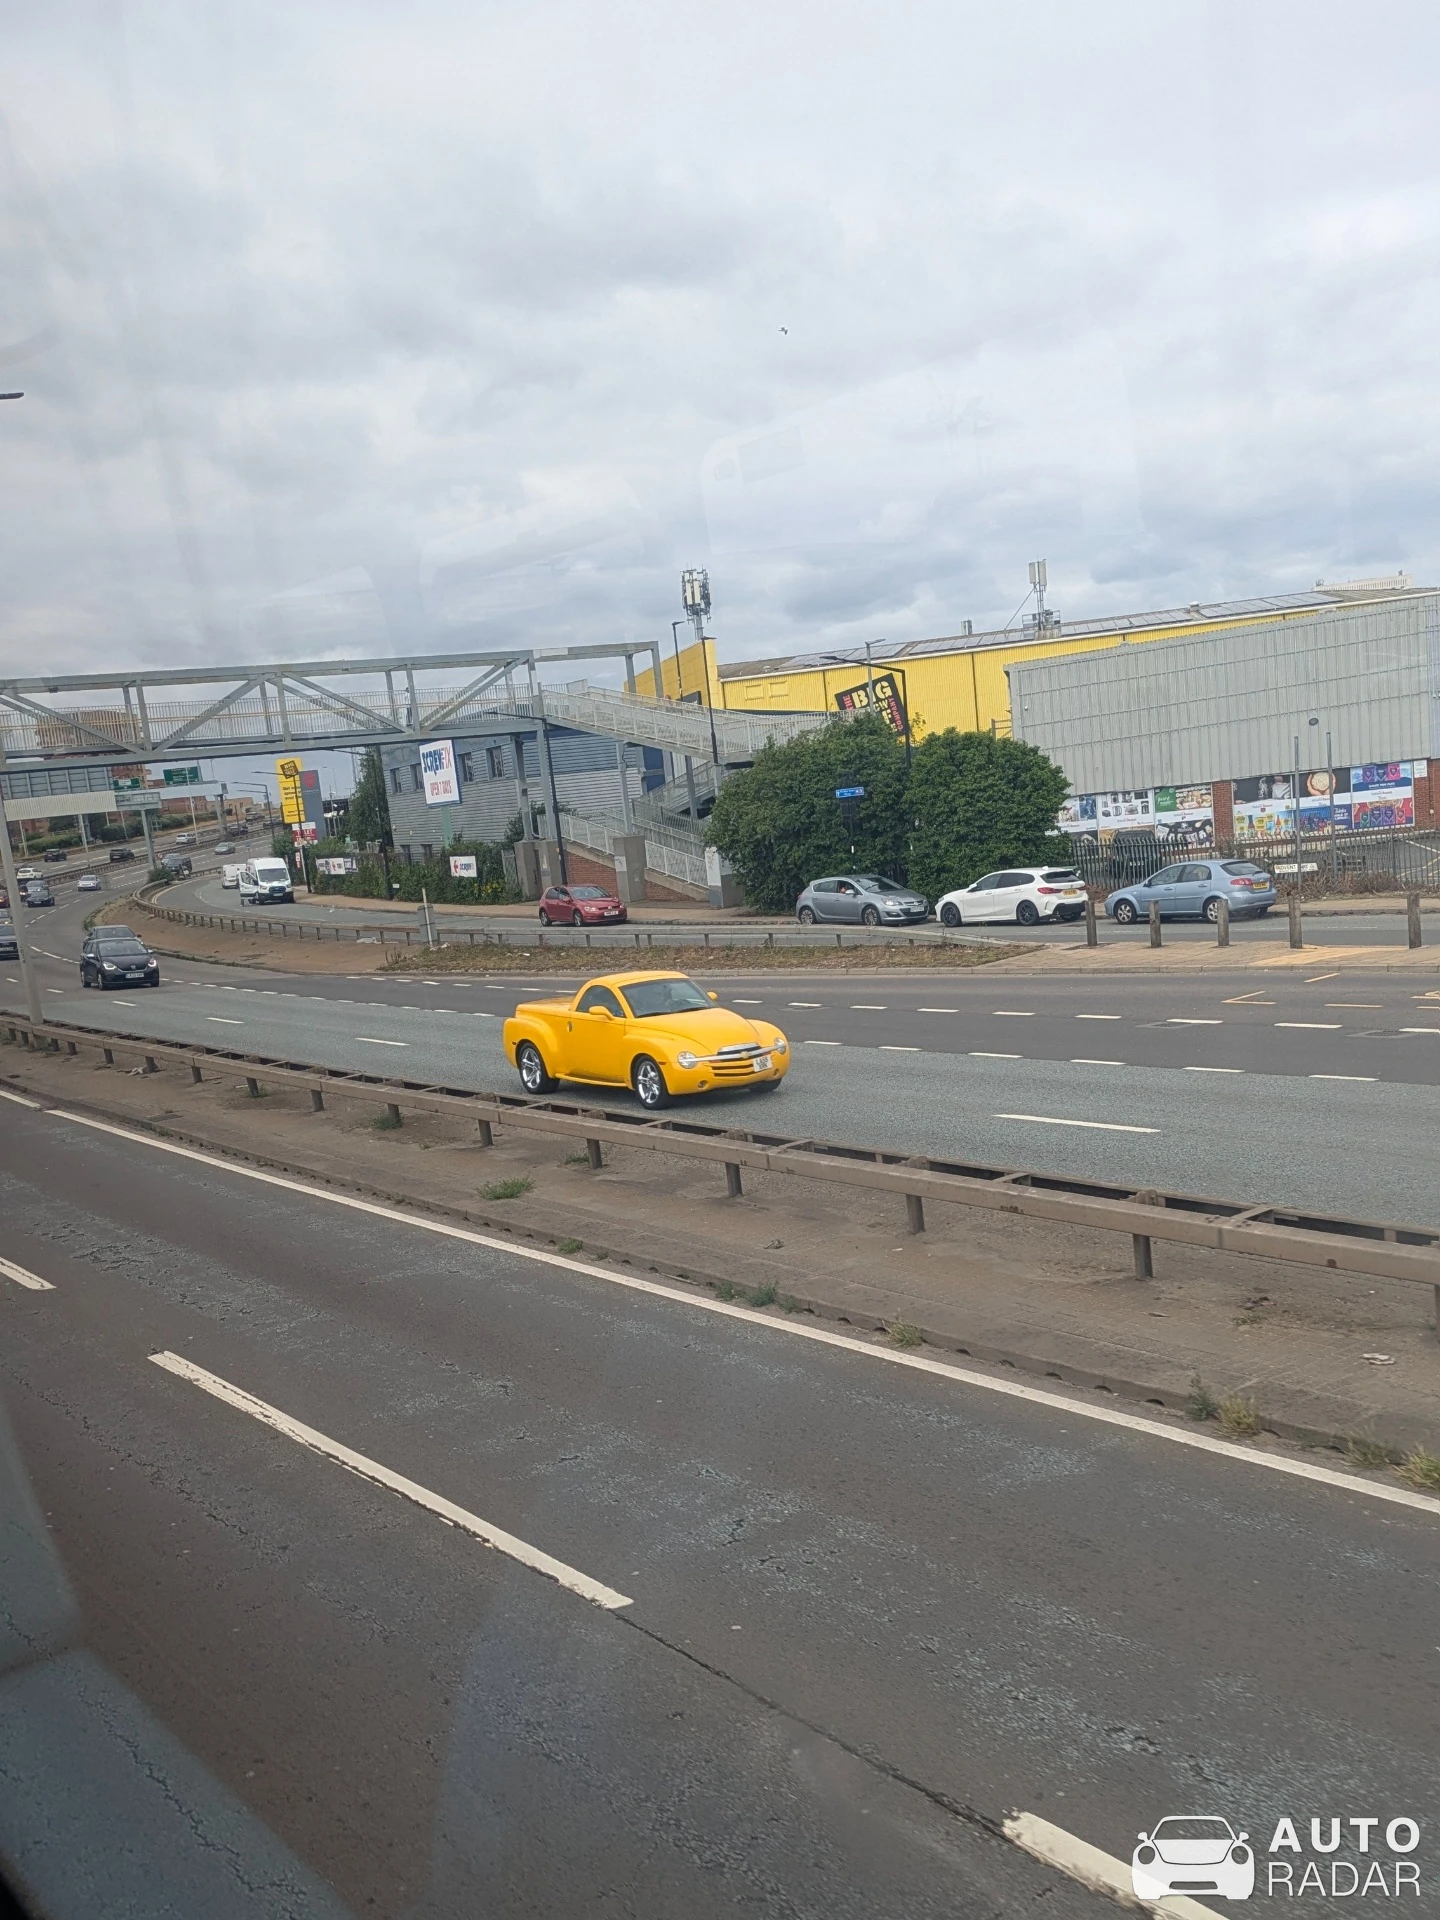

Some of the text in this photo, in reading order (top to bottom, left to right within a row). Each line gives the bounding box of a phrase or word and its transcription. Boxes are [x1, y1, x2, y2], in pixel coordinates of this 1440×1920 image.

[852, 681, 893, 708] BIG
[889, 697, 904, 731] COMPANY
[422, 746, 452, 776] SCREWFIX
[430, 782, 439, 796] OPEN
[442, 780, 452, 794] DAYS
